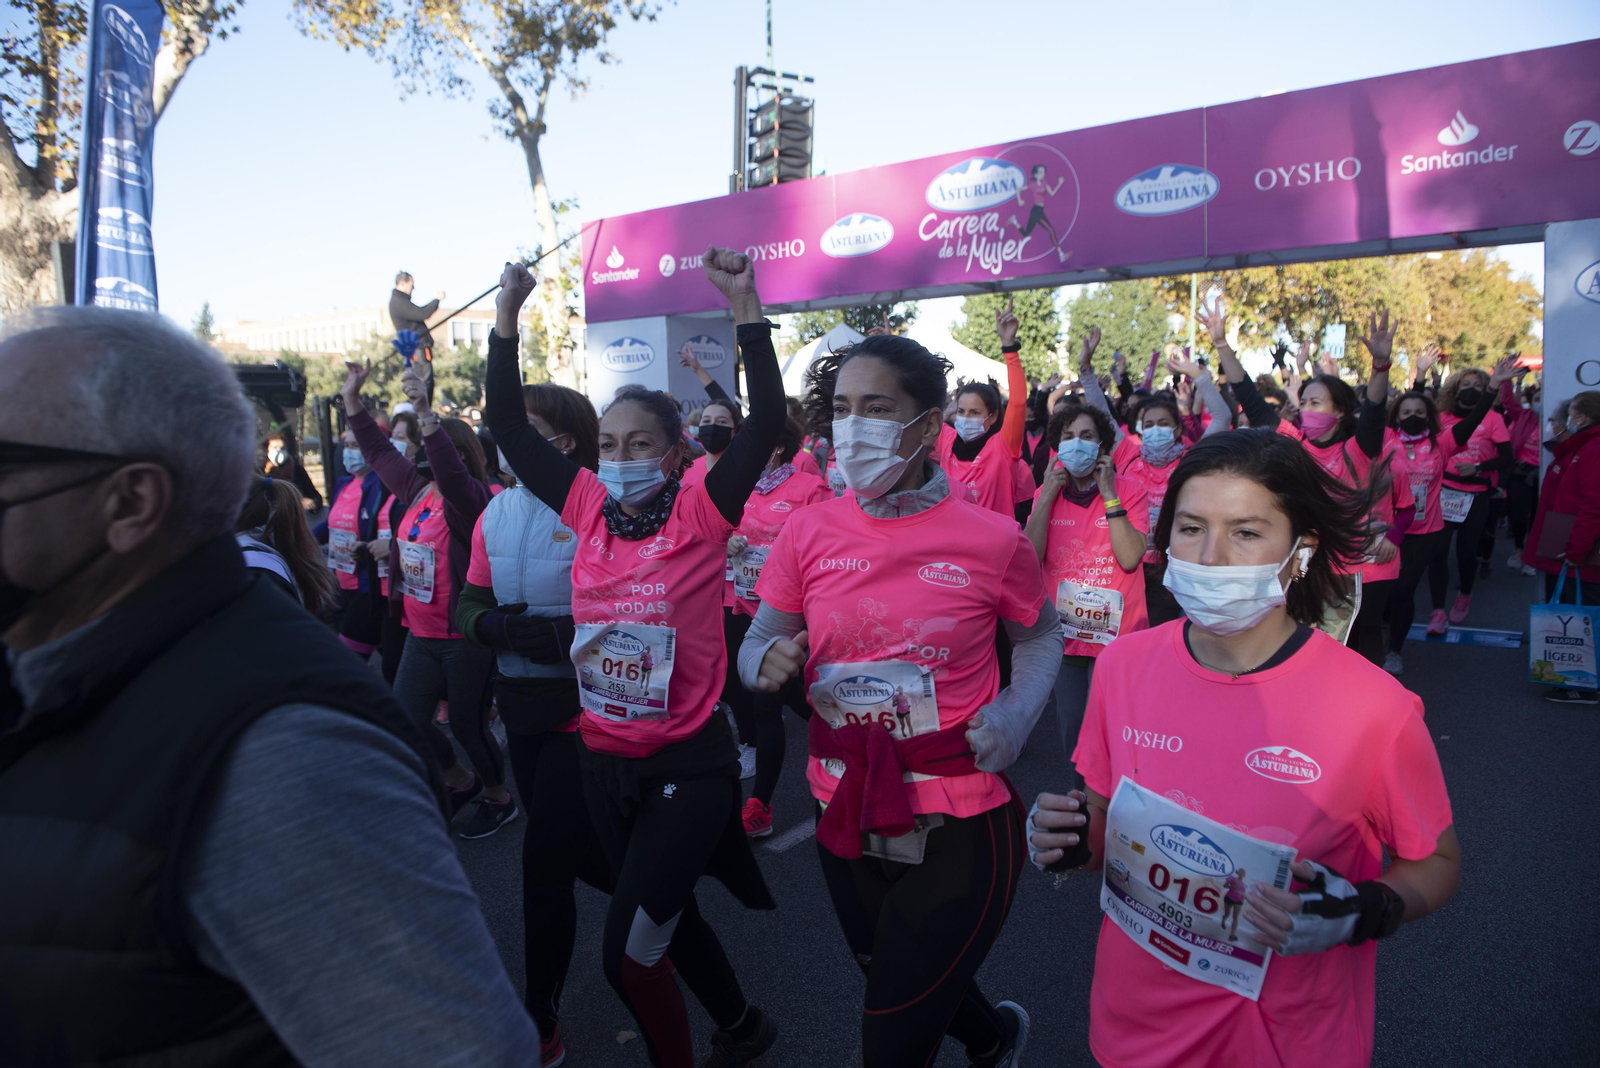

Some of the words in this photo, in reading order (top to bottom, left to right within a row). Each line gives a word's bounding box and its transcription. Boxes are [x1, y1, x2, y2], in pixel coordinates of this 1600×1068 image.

[1400, 144, 1518, 174] Santander
[1254, 157, 1362, 191] OYSHO
[935, 176, 1018, 203] ASTURIANA
[1123, 183, 1210, 208] ASTURIANA
[918, 212, 1000, 241] Carrera
[830, 230, 887, 248] ASTURIANA
[746, 238, 805, 262] OYSHO
[938, 243, 954, 260] de
[956, 236, 968, 257] la
[966, 226, 1032, 274] Mujer
[680, 255, 704, 270] ZUR
[592, 268, 639, 284] Santander
[607, 352, 650, 365] ASTURIANA
[694, 350, 723, 360] TURIANA
[405, 564, 419, 576] 016
[743, 567, 761, 577] 016
[820, 558, 870, 572] OYSHO
[1083, 567, 1114, 575] TODAS
[922, 568, 966, 584] ASTURIANA
[631, 583, 666, 596] POR
[1077, 595, 1104, 604] ASTURIANA
[614, 602, 667, 614] TODAS
[1075, 607, 1102, 620] 016
[603, 638, 640, 652] ASTURIANA
[1548, 637, 1582, 646] YBARRA
[908, 644, 950, 660] POR
[602, 658, 639, 681] 016
[608, 681, 626, 693] 2153
[839, 686, 890, 698] ASTURIANA
[627, 696, 648, 705] MUJER
[1122, 725, 1183, 753] OYSHO
[825, 758, 846, 771] OYSH
[1250, 755, 1315, 779] ASTURIANA
[1263, 754, 1288, 763] CENTRAL
[1289, 759, 1314, 768] LECHERA
[1169, 832, 1196, 848] CENTRAL
[1155, 830, 1226, 875] ASTURIANA
[1149, 863, 1220, 914] 016
[1107, 897, 1144, 935] OYSHO
[1158, 902, 1193, 928] 4903
[1124, 896, 1164, 925] CARRERA
[1165, 920, 1178, 933] DE
[1179, 928, 1193, 942] LA
[1194, 934, 1234, 955] MUJER
[1214, 965, 1250, 982] ZURICH
